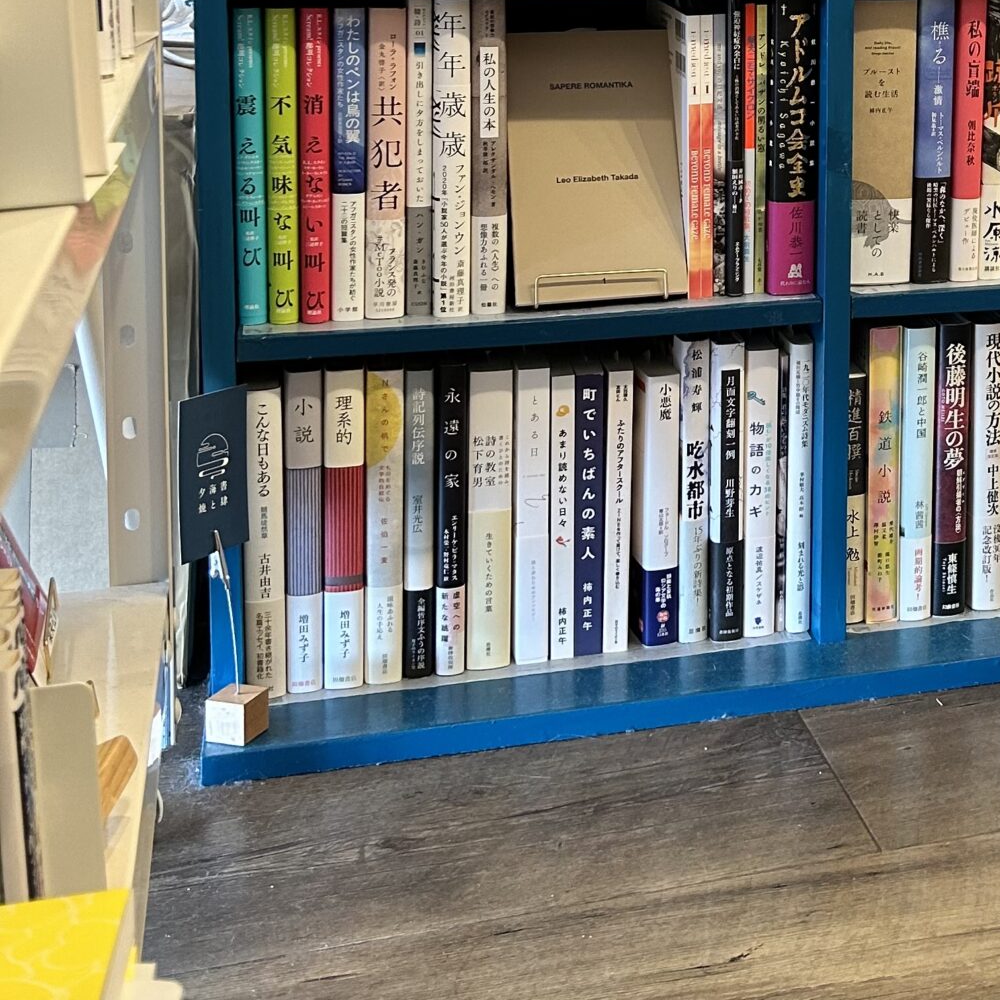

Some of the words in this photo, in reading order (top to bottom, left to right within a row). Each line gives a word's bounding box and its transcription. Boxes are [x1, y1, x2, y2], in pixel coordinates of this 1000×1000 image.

[345, 17, 361, 143] わたしのペンは鳥の翼
[439, 12, 466, 157] 年年歳歳
[483, 53, 496, 131] 私の人生の本
[863, 68, 900, 76] プルースト
[864, 90, 899, 98] 読む生活
[966, 21, 982, 99] 私の盲端
[415, 62, 424, 203] 引き出しに夕方をしまっておいた
[787, 15, 809, 198] アドルムコ会全史
[966, 120, 975, 165] 朝比奈秋
[370, 99, 403, 211] 共犯者
[573, 175, 608, 183] Elizabeth
[454, 165, 466, 255] ファン・ジョンウン
[789, 207, 803, 258] 佐川恭一
[294, 398, 314, 443] 小説
[335, 396, 352, 445] 理系的
[659, 384, 672, 420] 小悪魔
[691, 350, 702, 414] 松浦寿輝
[917, 352, 927, 438] 谷崎潤一郎と中国
[943, 343, 966, 470] 後藤明生の夢
[985, 332, 1000, 446] 現代小説の方法
[255, 404, 270, 497] こんな日もある
[444, 388, 461, 488] 永遠の家
[473, 436, 482, 488] 松下育男
[485, 436, 496, 486] 詩の教室
[530, 396, 538, 457] とある日
[877, 410, 892, 503] 鉄道小説
[558, 429, 567, 528] あまり読めない日々
[581, 388, 596, 560] 町でいちばんの素人
[687, 440, 704, 520] 吃水都市
[749, 422, 764, 518] 物語のカギ
[987, 464, 999, 516] 中上健次
[259, 553, 271, 599] 古井由吉
[583, 583, 593, 630] 柿内正午
[299, 614, 308, 663] 増田みず子
[340, 610, 350, 658] 増田みず子
